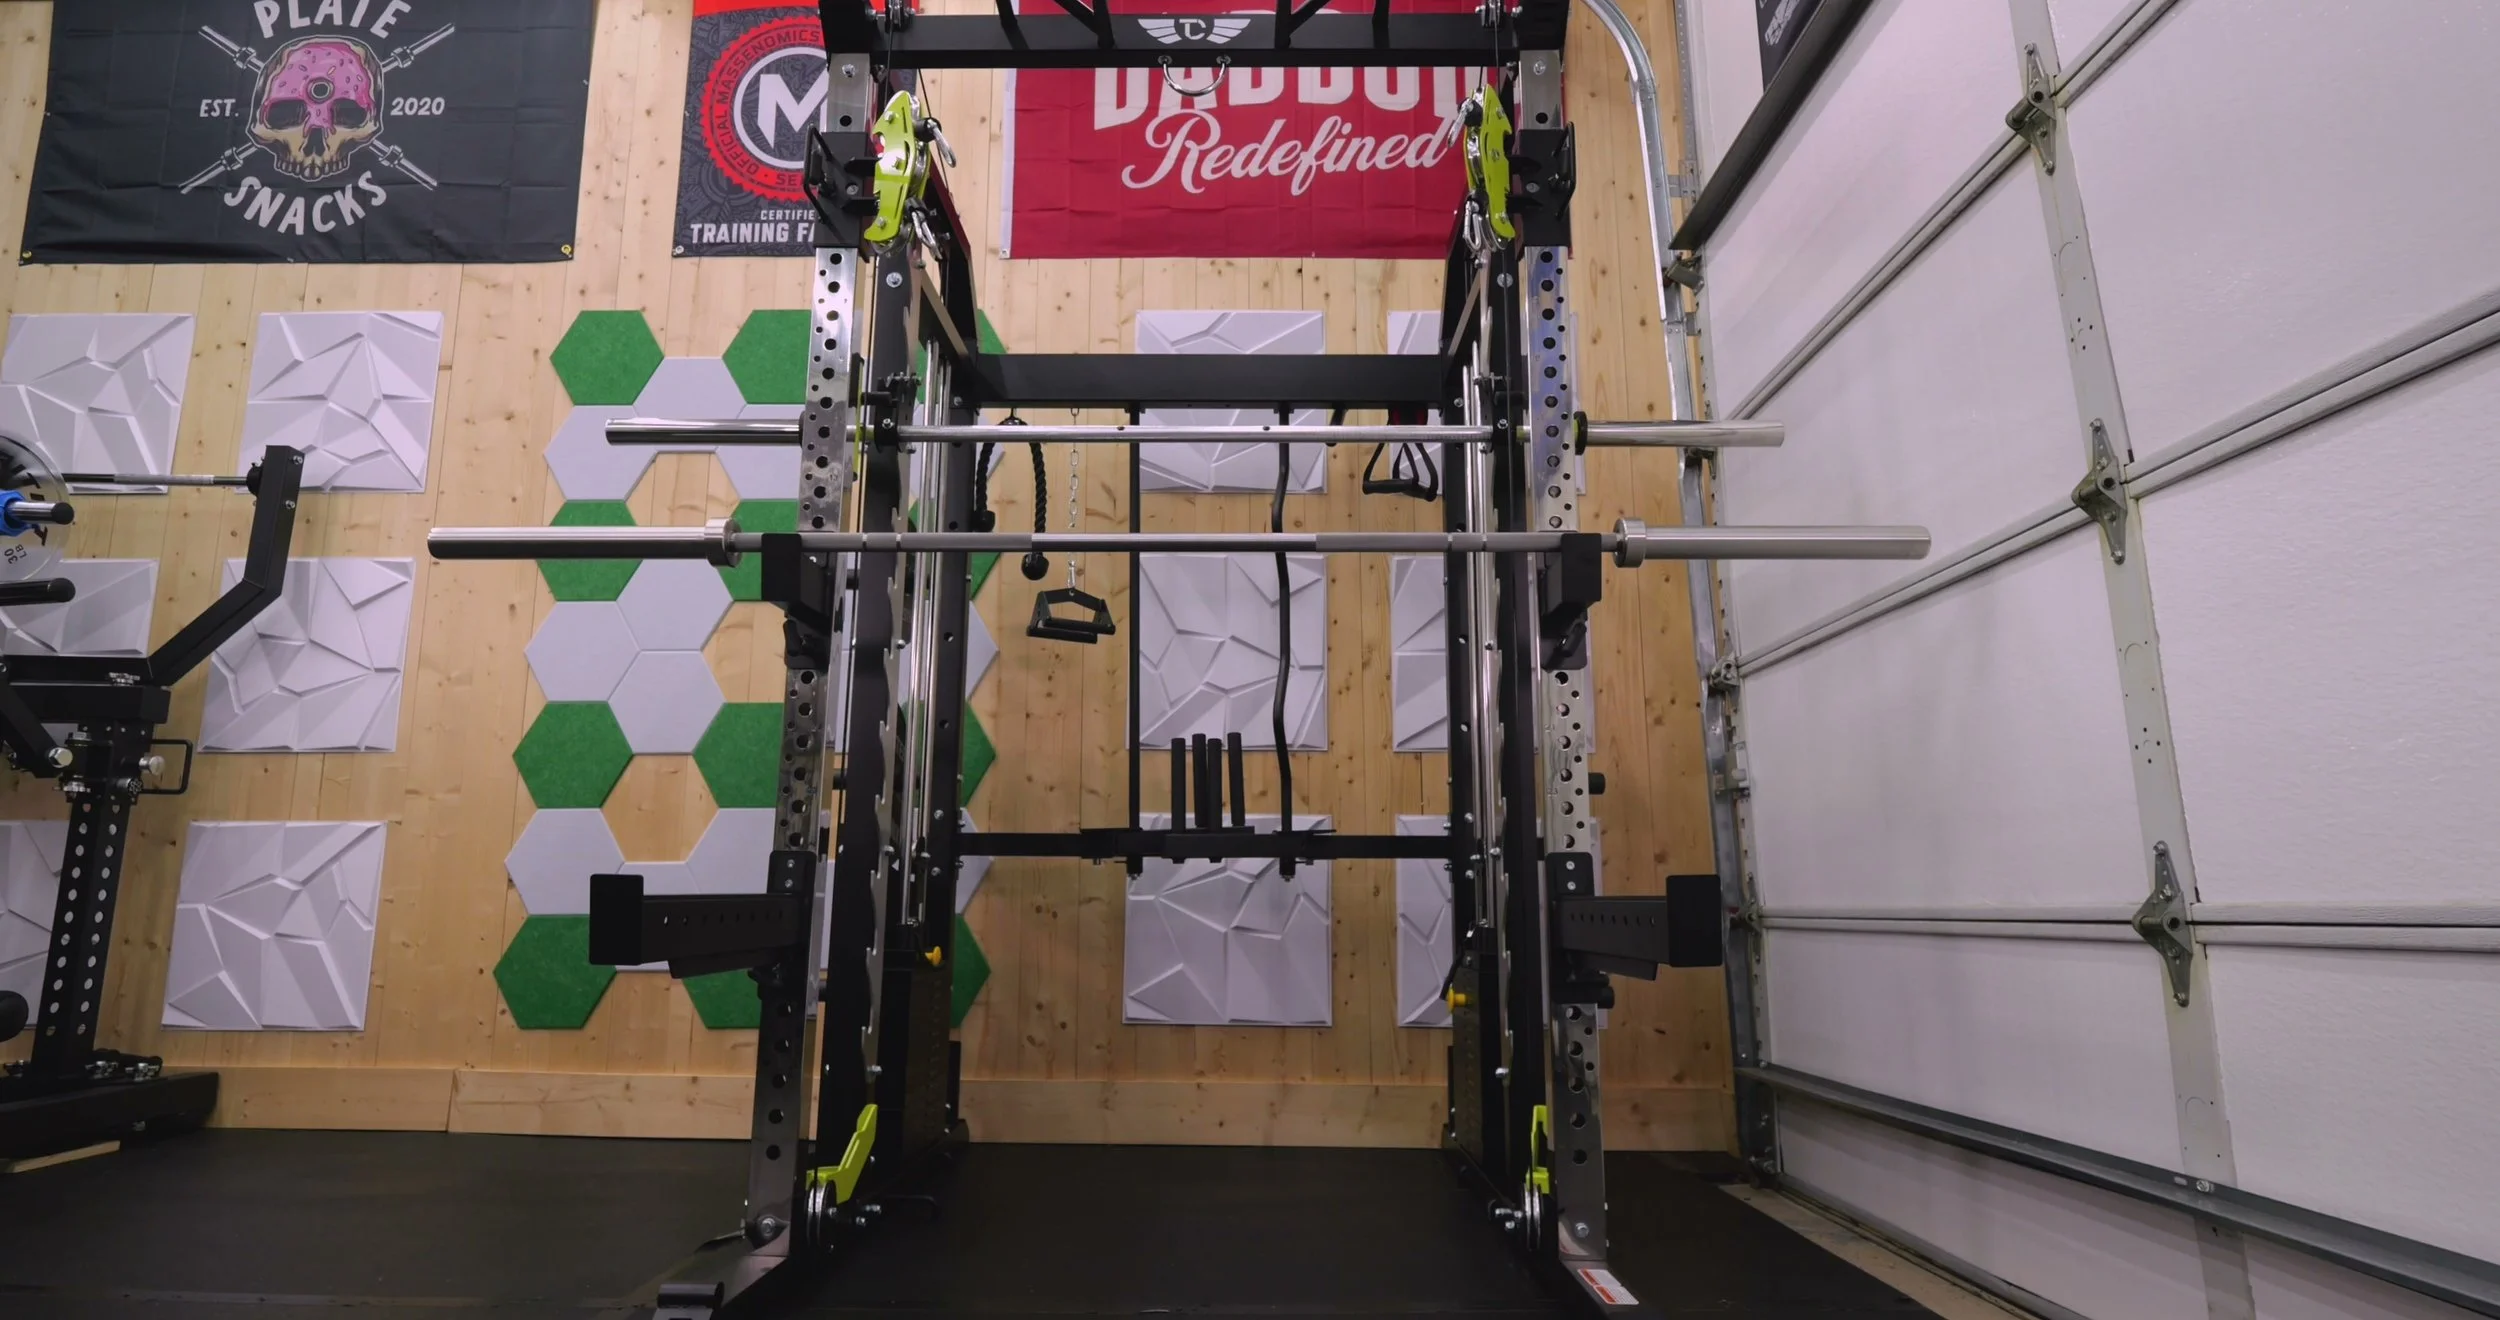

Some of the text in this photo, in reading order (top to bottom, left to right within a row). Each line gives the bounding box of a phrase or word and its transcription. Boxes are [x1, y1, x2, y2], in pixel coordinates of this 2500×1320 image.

[718, 29, 820, 104] MASSENOMICS
[199, 98, 240, 118] EST.
[389, 97, 446, 116] 2020
[716, 109, 761, 176] OFFICIAL
[1121, 114, 1465, 196] Redefined
[223, 170, 388, 236] SNACKS
[760, 209, 815, 221] CERTIFIE
[689, 222, 790, 244] TRAINING
[4, 548, 18, 564] 30
